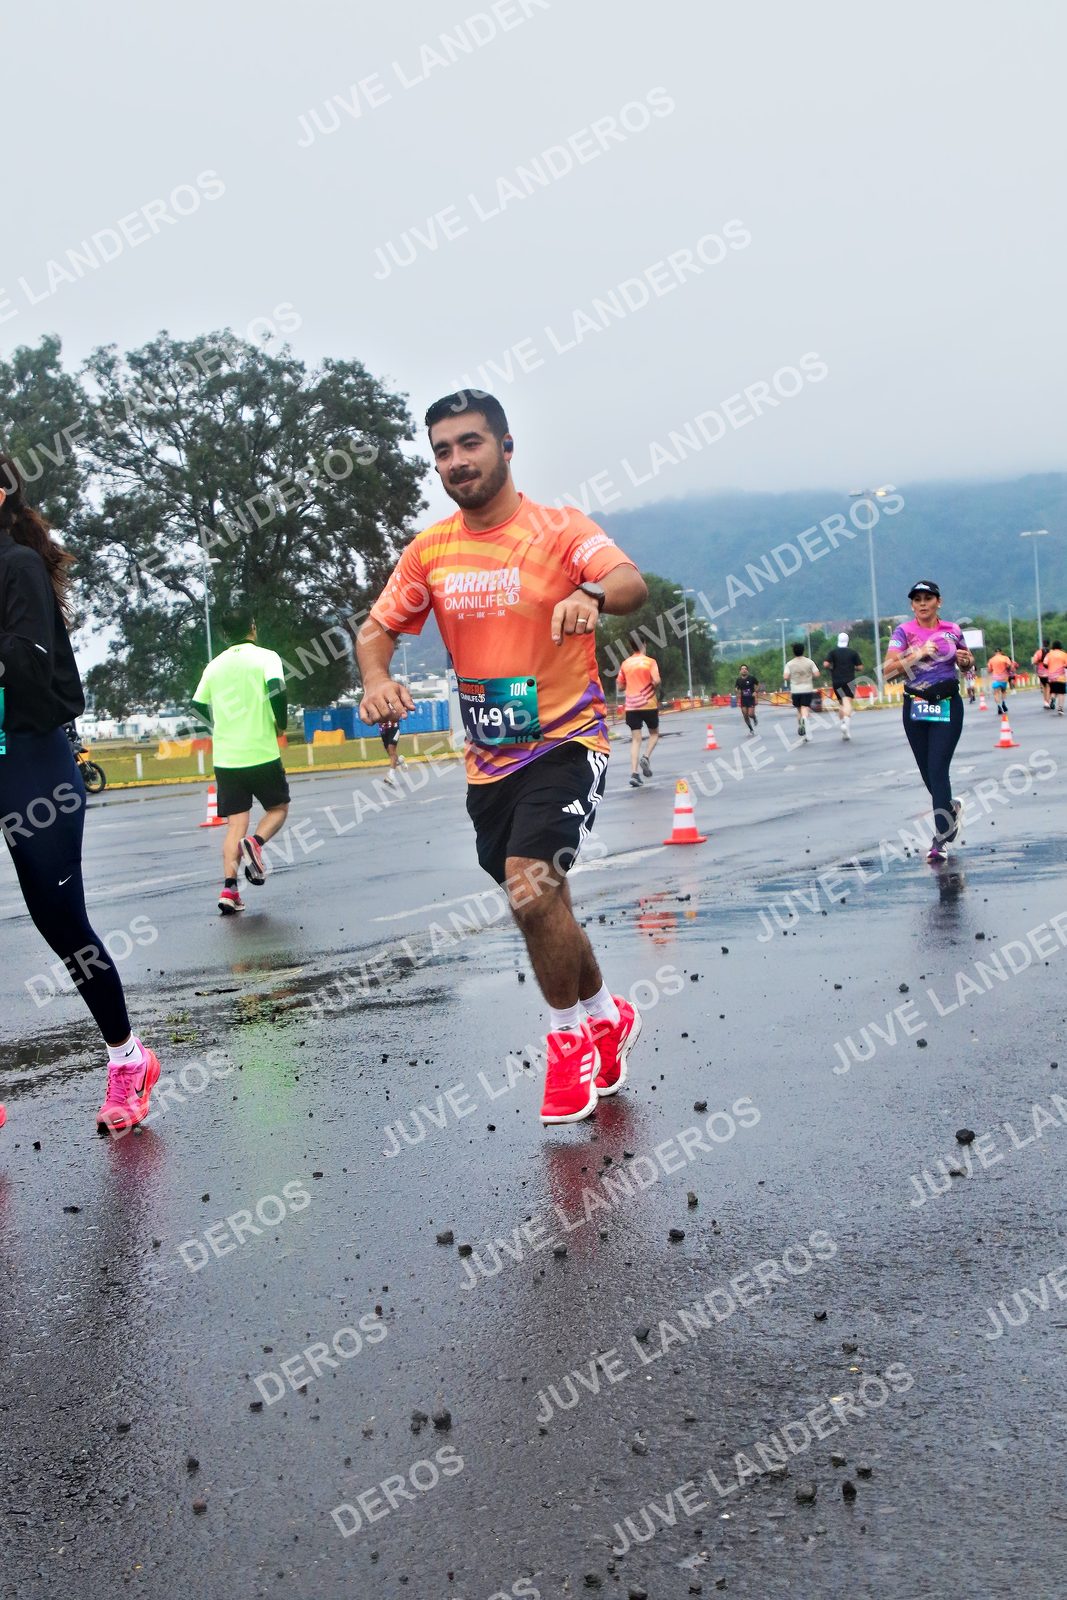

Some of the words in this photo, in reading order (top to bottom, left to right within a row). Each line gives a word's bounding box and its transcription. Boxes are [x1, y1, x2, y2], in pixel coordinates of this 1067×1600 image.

[444, 567, 521, 594] CARRERA
[444, 594, 503, 610] OMNILIFE
[510, 682, 527, 696] 10K
[469, 706, 516, 726] 1491
[917, 704, 941, 714] 1268
